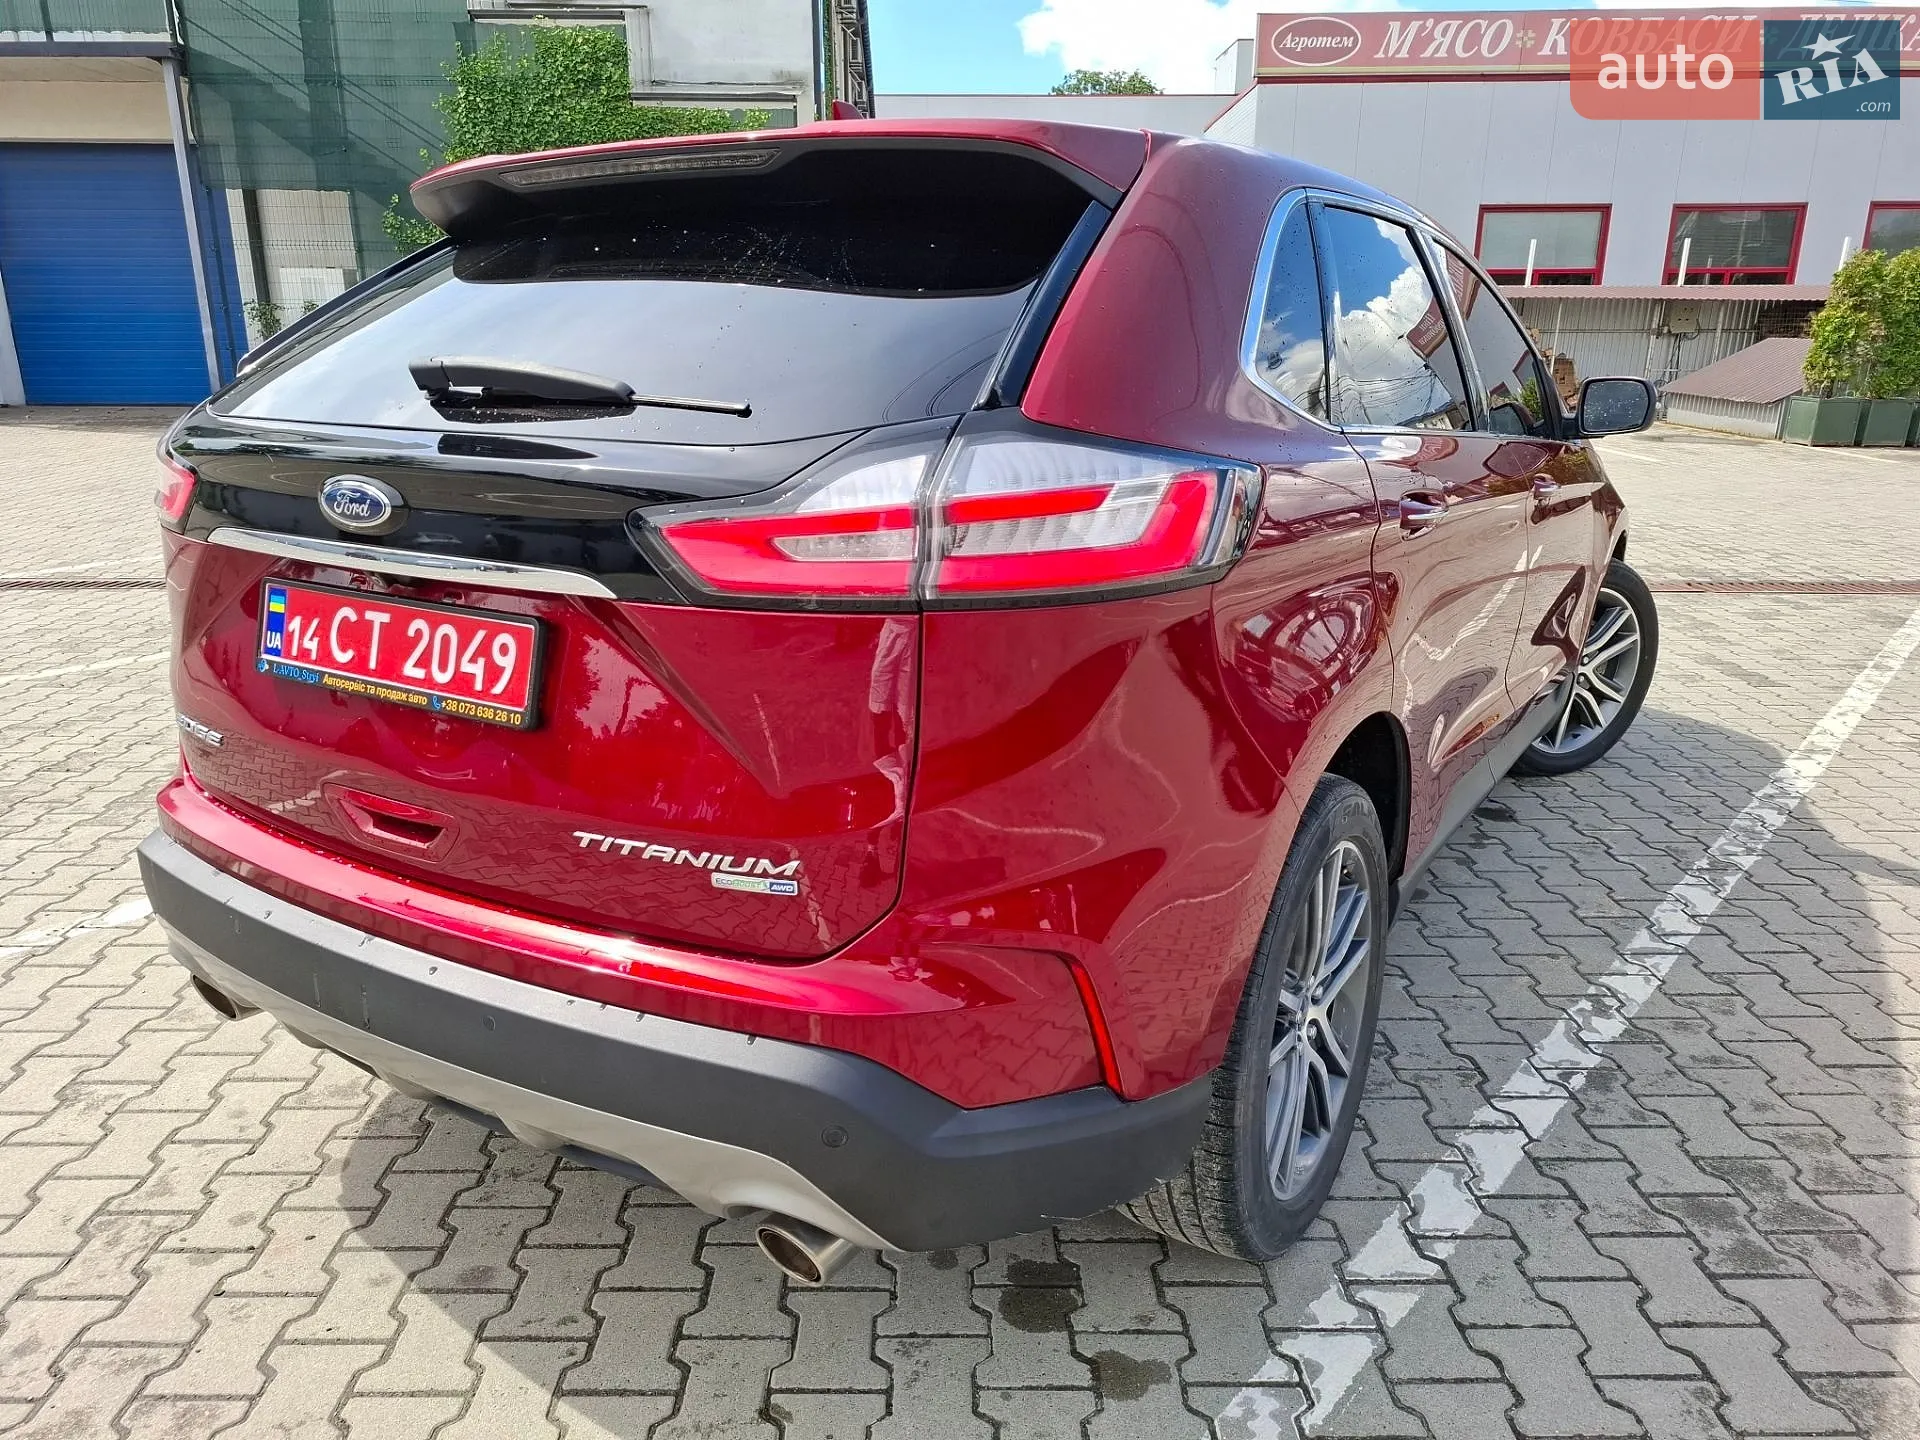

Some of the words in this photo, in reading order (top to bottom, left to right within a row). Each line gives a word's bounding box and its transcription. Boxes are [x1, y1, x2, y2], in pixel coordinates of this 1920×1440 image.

[1279, 31, 1355, 52] Агротем
[1374, 18, 1514, 58] М'ЯСО
[1541, 15, 1758, 57] КОВБАСИ
[333, 489, 371, 517] Ford
[266, 630, 281, 650] UA
[287, 615, 321, 661] 14
[402, 618, 518, 696] 2049
[323, 673, 365, 692] Автосервіс
[367, 684, 376, 694] та
[376, 687, 407, 701] продаж
[408, 691, 428, 705] авто
[441, 699, 457, 712] +38
[458, 702, 476, 716] 073
[477, 706, 494, 719] 636
[495, 710, 507, 722] 26
[509, 713, 521, 725] 10
[572, 830, 801, 876] TITANIUM
[770, 884, 794, 892] AWD
